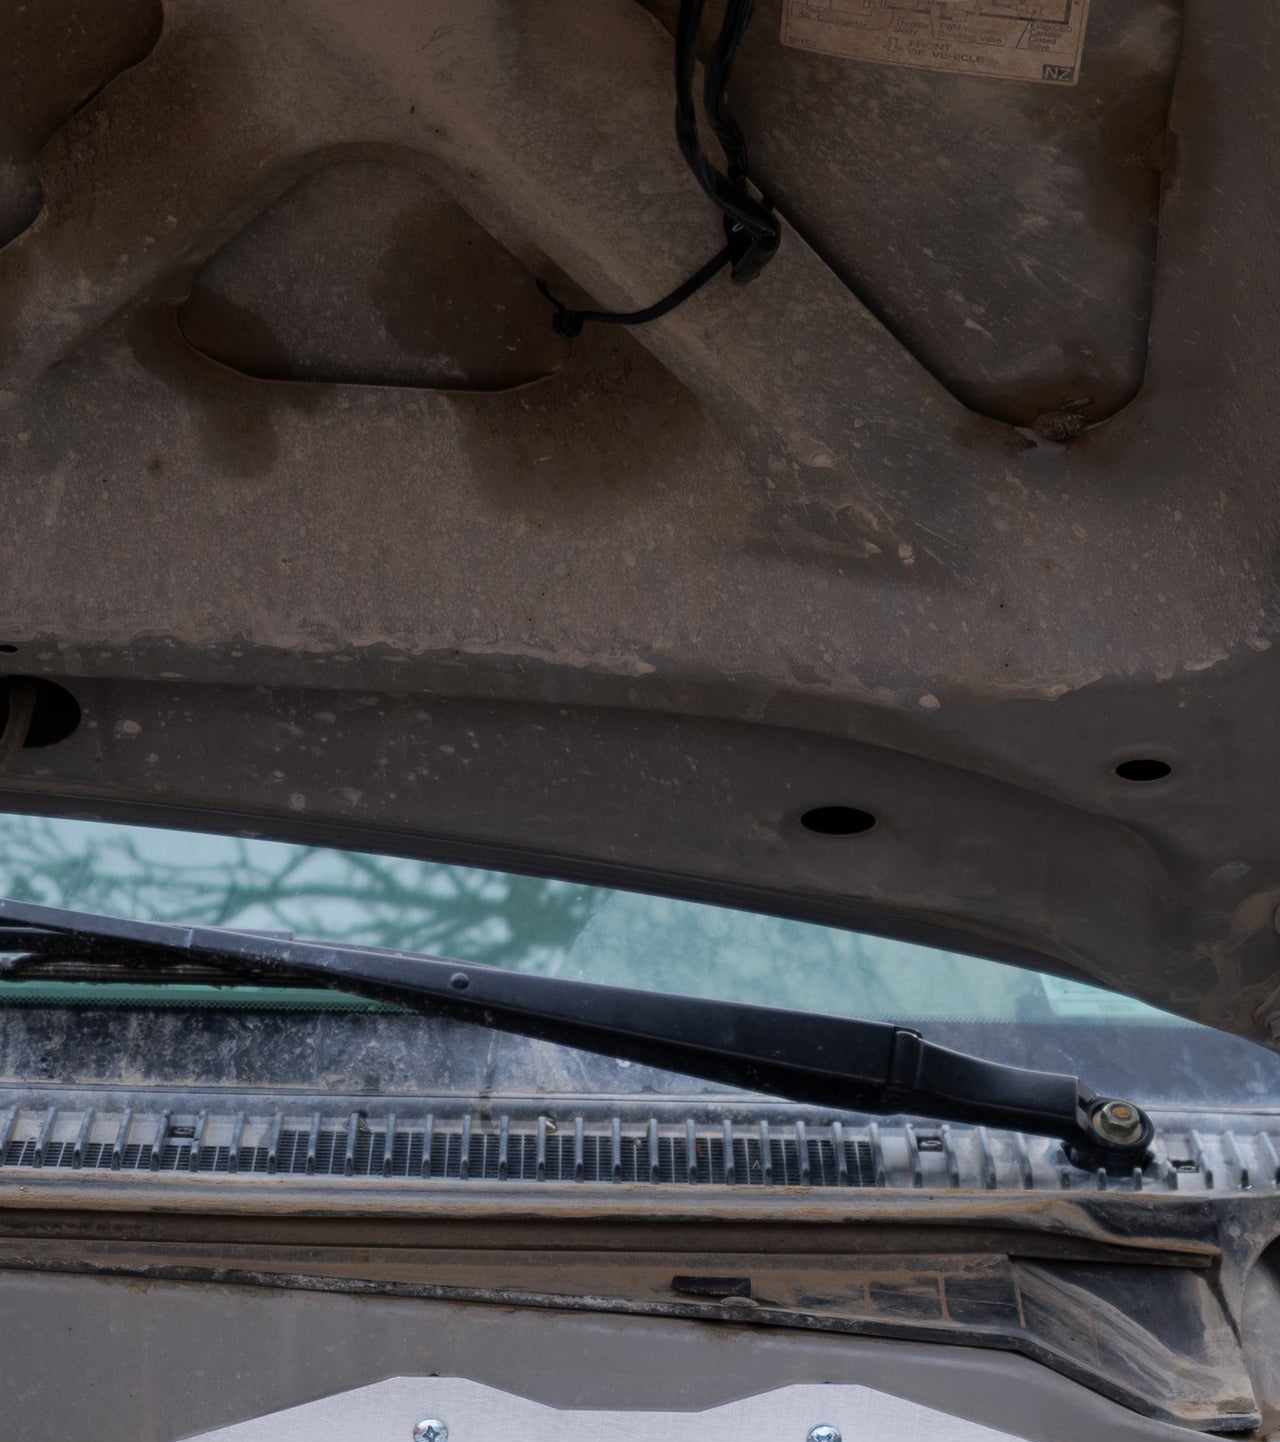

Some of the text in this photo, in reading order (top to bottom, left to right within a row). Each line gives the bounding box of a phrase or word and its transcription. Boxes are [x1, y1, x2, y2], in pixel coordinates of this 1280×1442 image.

[908, 39, 953, 52] FRONT
[1028, 36, 1057, 45] Closed
[907, 48, 986, 64] OF VEHICLE
[1045, 66, 1072, 81] NZ
